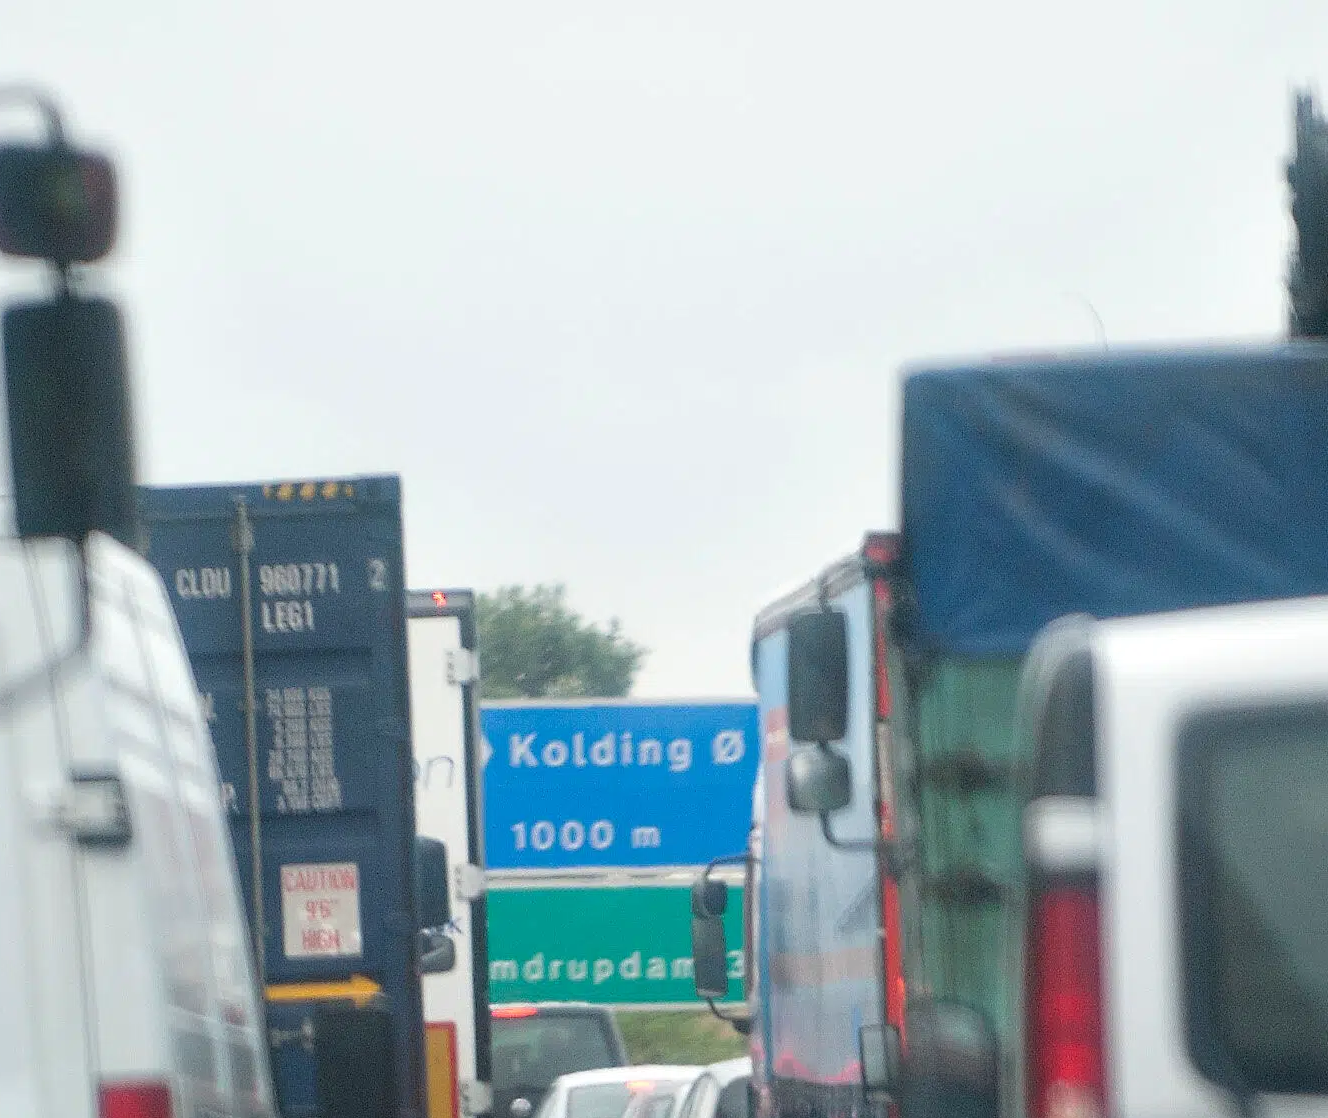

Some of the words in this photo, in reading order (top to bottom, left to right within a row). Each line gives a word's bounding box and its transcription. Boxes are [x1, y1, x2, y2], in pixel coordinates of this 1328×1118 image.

[259, 562, 340, 596] 960771
[368, 557, 387, 592] 2
[509, 730, 694, 773] Kolding
[711, 729, 745, 765] Ø
[510, 819, 615, 851] 1000
[630, 826, 662, 849] m
[283, 868, 357, 893] CAUTION
[302, 929, 342, 951] HIGH
